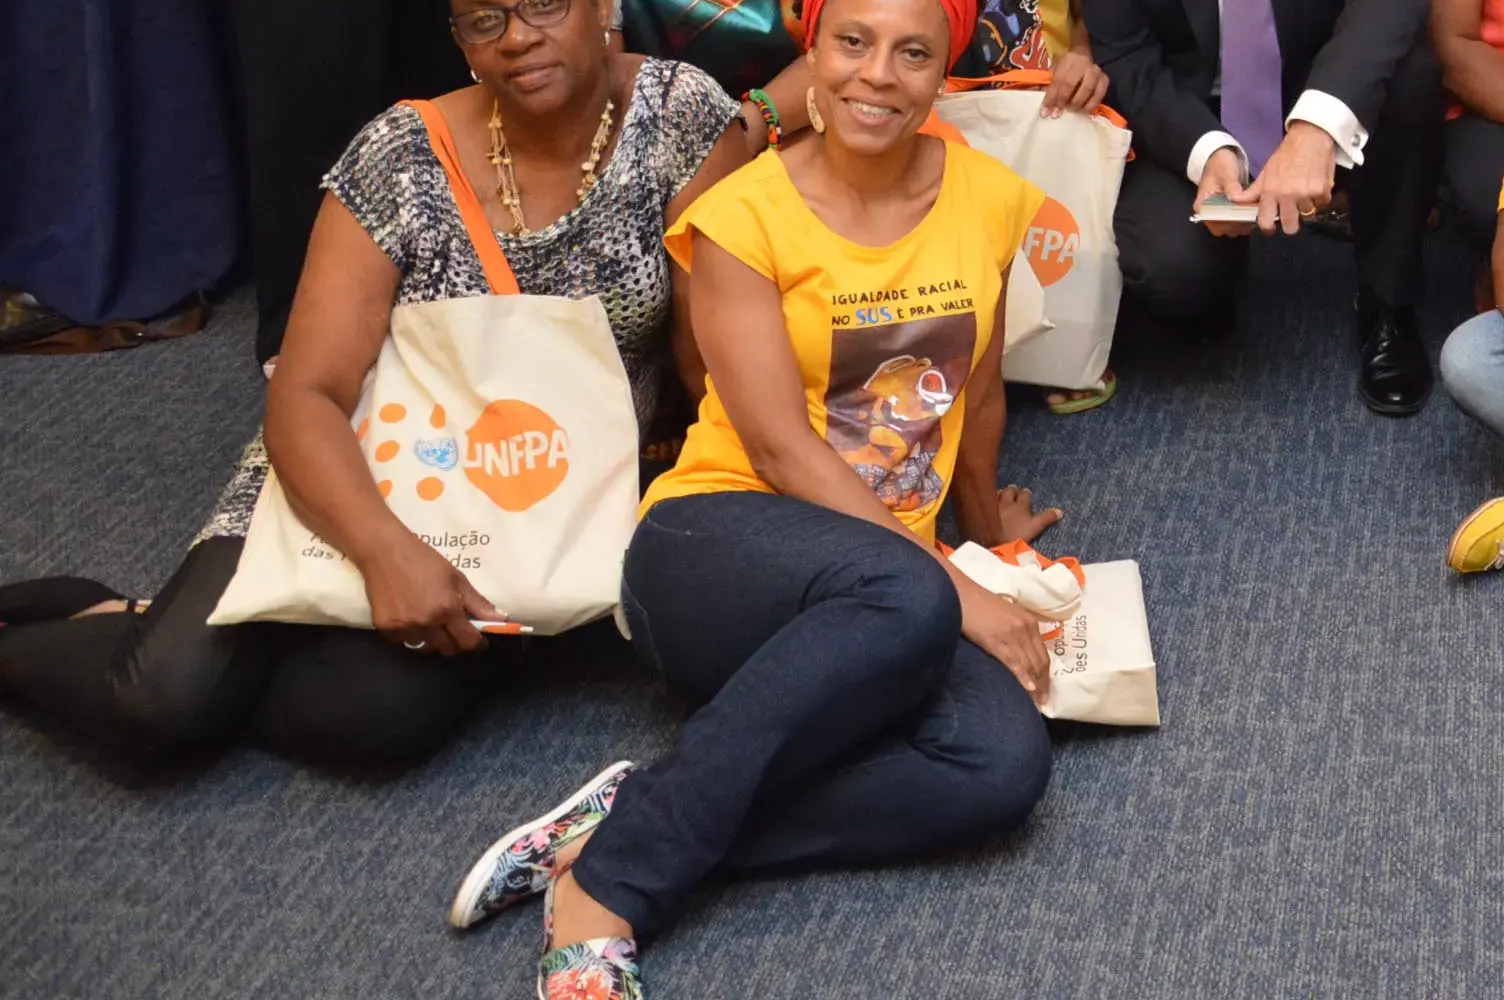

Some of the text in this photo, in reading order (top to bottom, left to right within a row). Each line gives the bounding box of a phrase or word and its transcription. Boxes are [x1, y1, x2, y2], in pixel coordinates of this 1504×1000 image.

[1023, 226, 1081, 263] FPA
[832, 279, 967, 306] IGUALDADE RACIAL
[831, 315, 850, 326] NO
[855, 306, 893, 326] SUS
[910, 305, 935, 317] PRA
[940, 298, 974, 312] VALER
[463, 429, 572, 478] UNFPA
[302, 546, 334, 560] das
[413, 530, 490, 550] pulação
